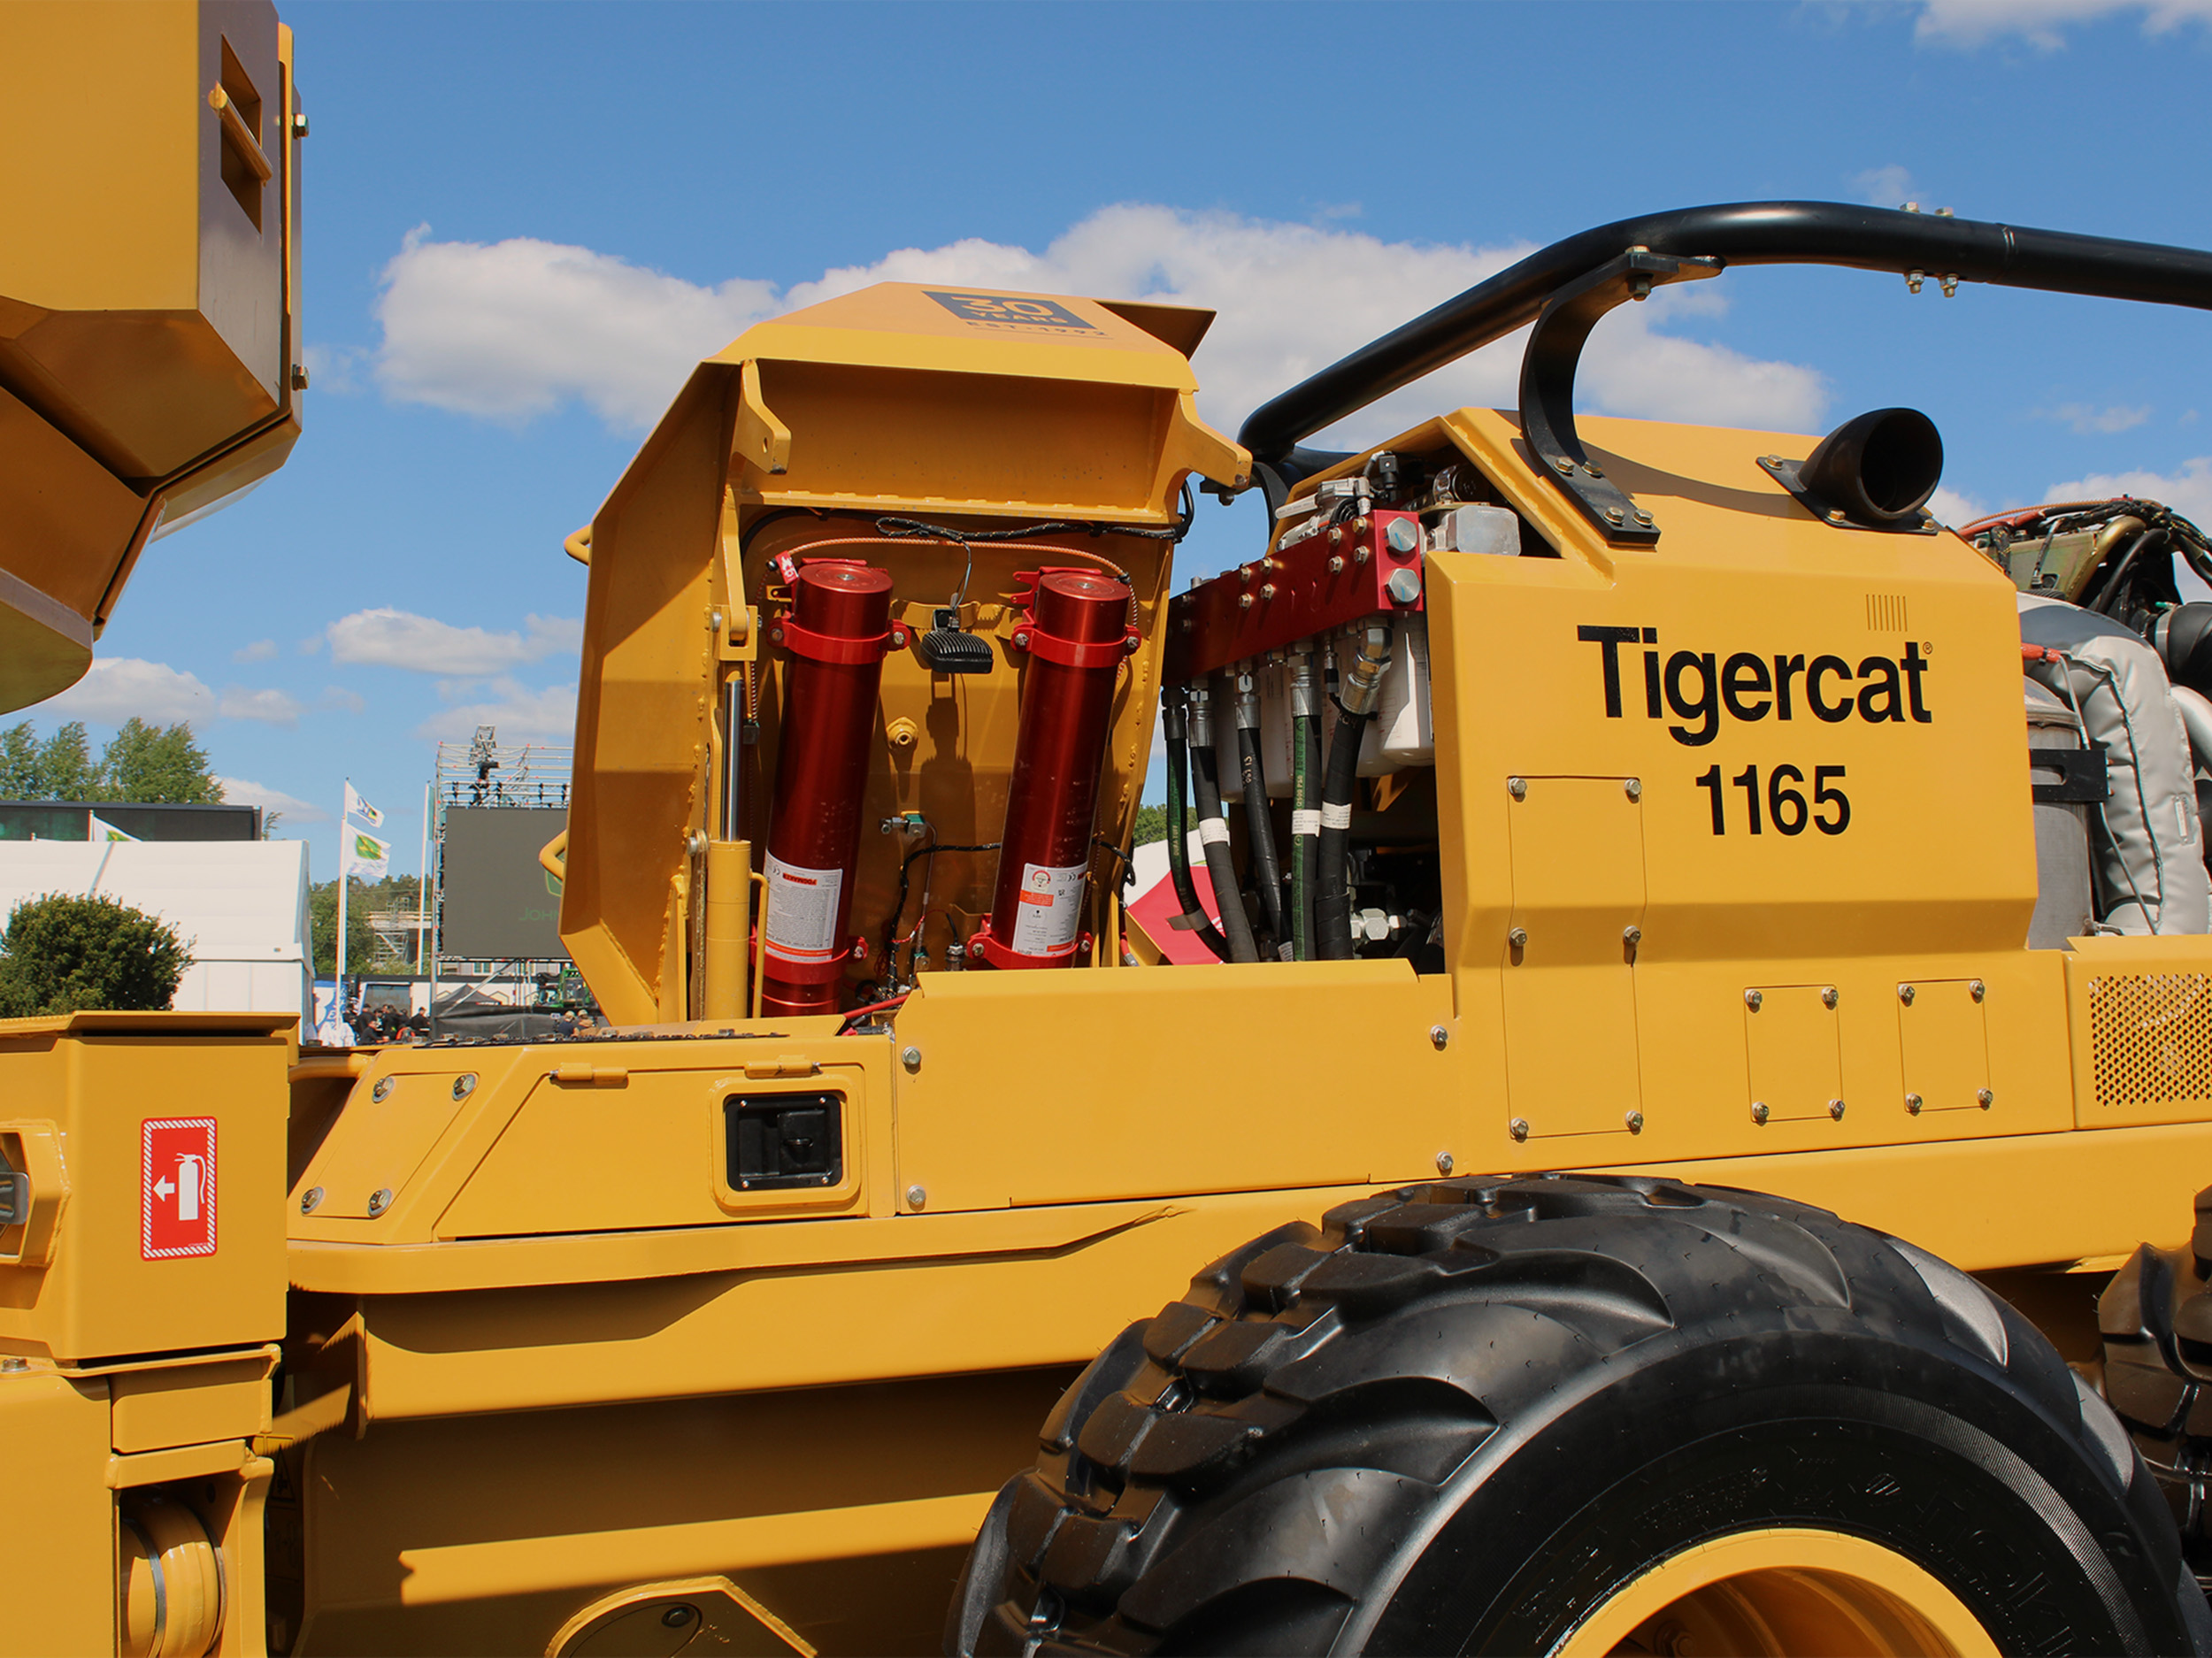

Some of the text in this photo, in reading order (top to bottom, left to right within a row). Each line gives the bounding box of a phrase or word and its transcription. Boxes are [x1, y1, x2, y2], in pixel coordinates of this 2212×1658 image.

[951, 296, 1054, 317] 30
[972, 311, 1069, 324] YEARS
[1695, 764, 1851, 836] 1165
